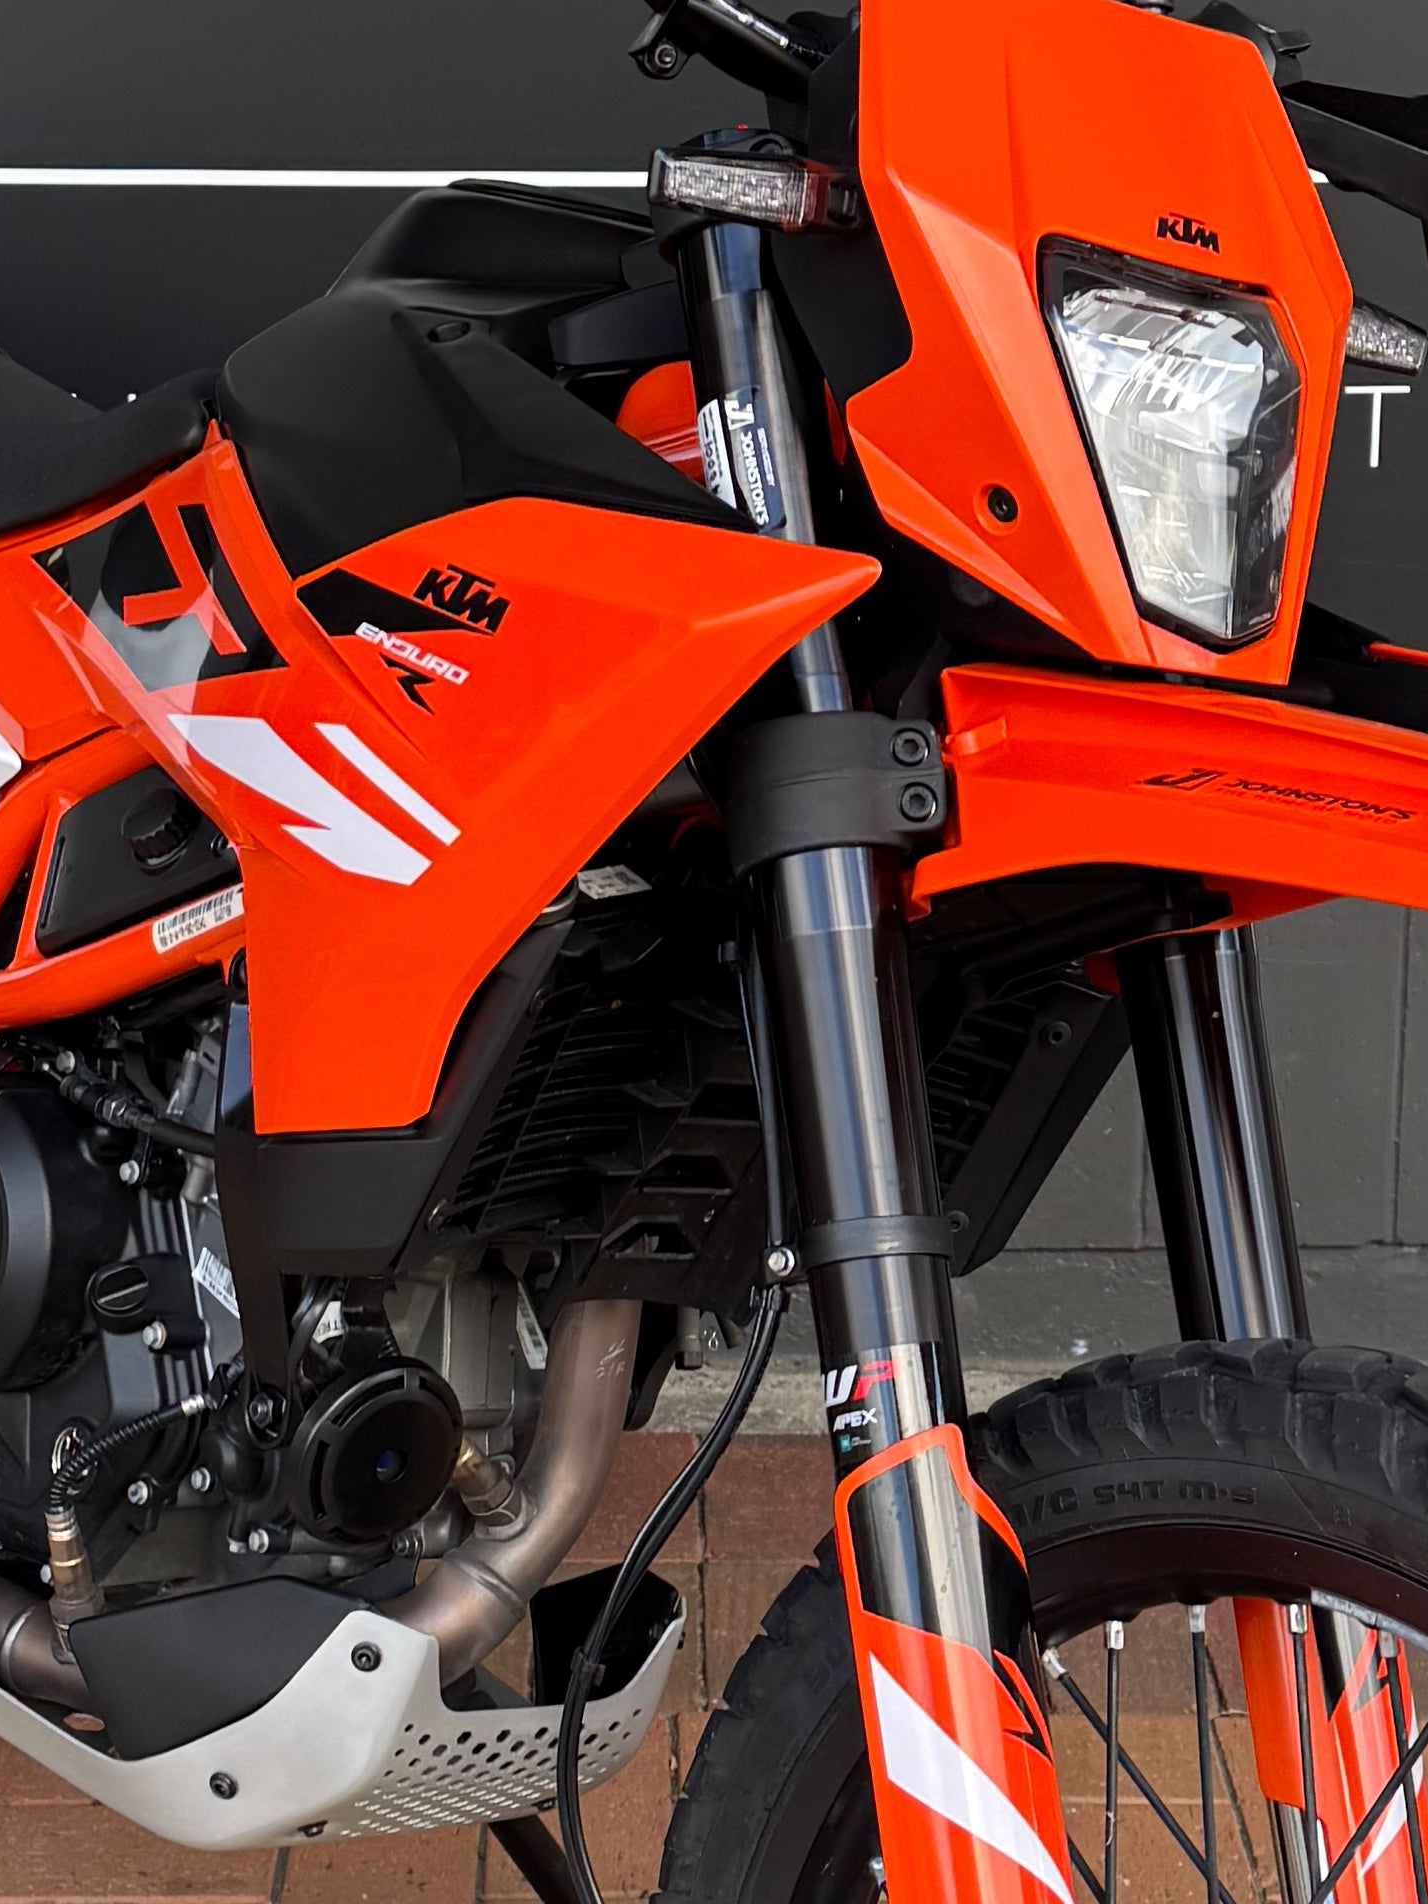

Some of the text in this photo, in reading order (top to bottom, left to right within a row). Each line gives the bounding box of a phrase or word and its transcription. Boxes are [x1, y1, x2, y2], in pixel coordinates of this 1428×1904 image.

[1158, 212, 1219, 253] KTM
[413, 564, 511, 635] KTM
[355, 621, 470, 685] ENDURO
[833, 1408, 879, 1433] APEX
